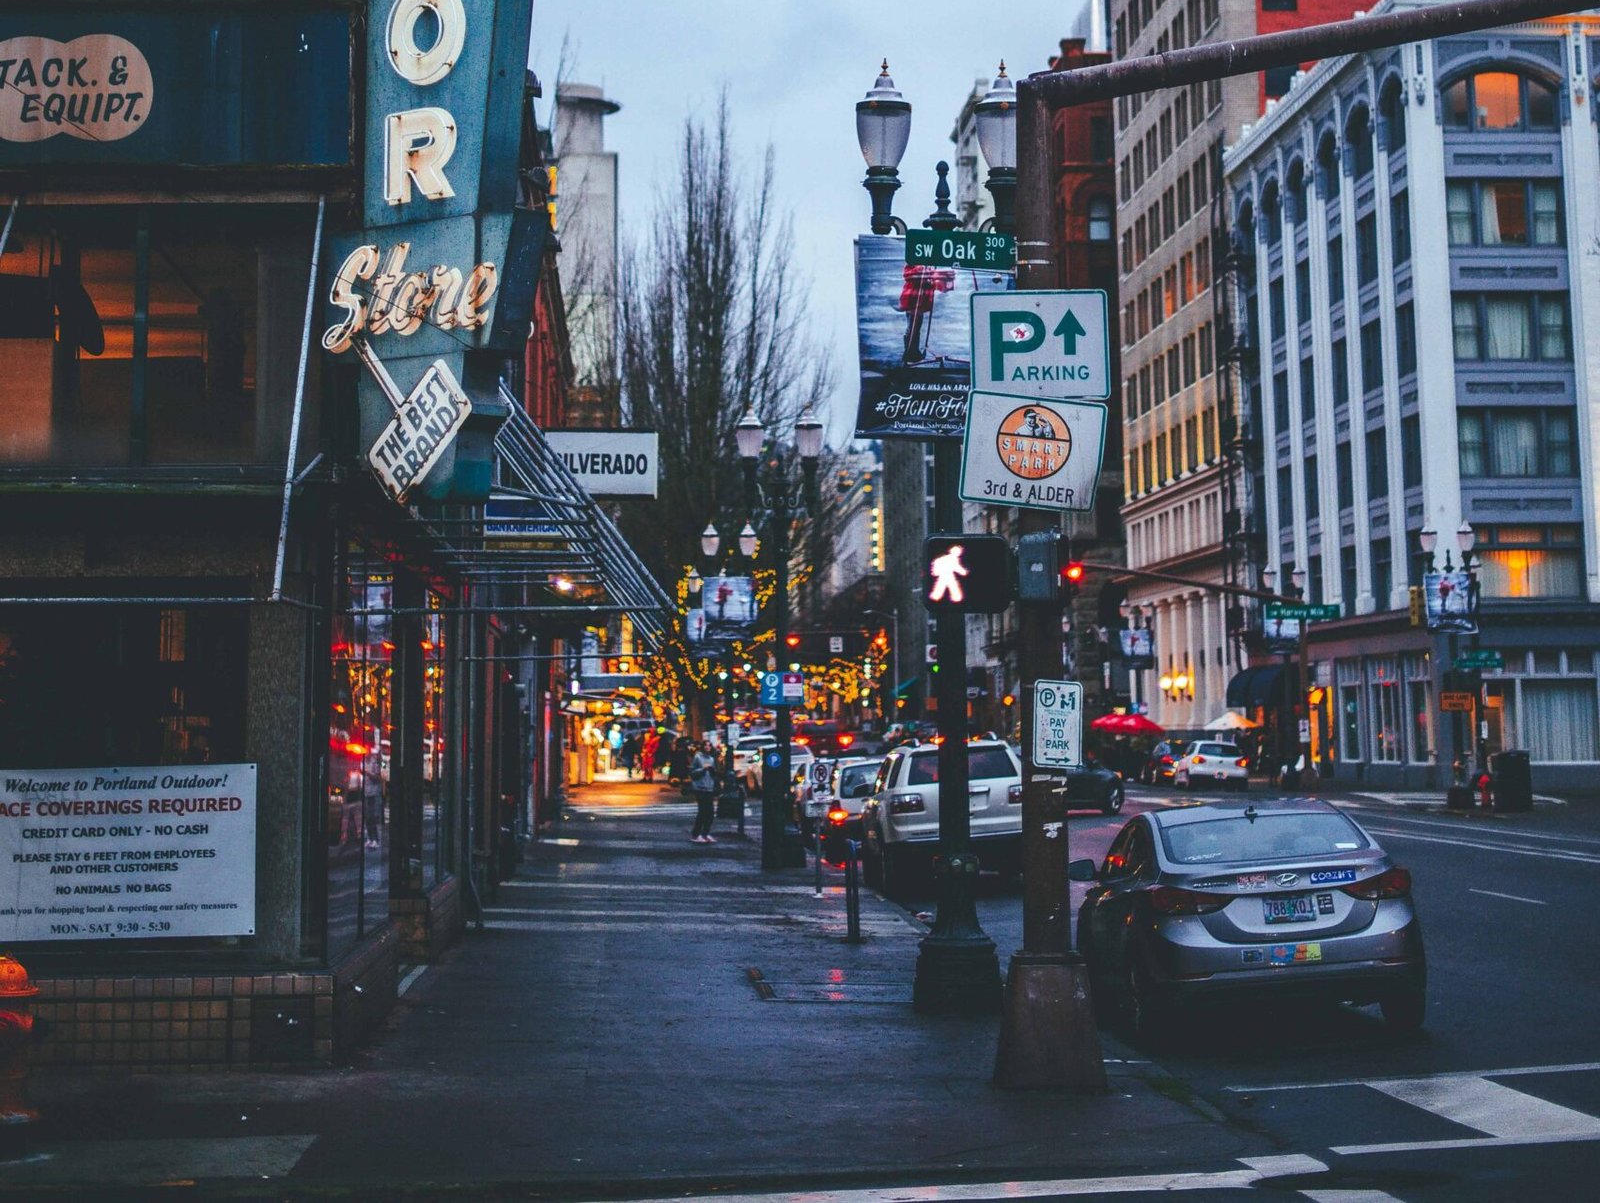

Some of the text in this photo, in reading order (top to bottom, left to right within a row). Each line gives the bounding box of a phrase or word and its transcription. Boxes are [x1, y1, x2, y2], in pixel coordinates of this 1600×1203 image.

[108, 55, 128, 86] &
[20, 92, 143, 125] EQUIPT.
[915, 239, 995, 261] SW Oak St
[985, 237, 1005, 248] 300
[322, 242, 498, 354] Store
[375, 371, 447, 469] THE BEST
[1002, 439, 1065, 456] SMART
[557, 452, 648, 476] ILVERADO
[1008, 455, 1056, 471] PARK
[984, 480, 1075, 504] 3rd & ALDER
[768, 688, 777, 701] 2
[1049, 718, 1067, 728] PAY
[1052, 729, 1064, 739] TO
[1045, 740, 1070, 750] PARK
[5, 774, 228, 793] Welcome to Portland Outdoor!
[36, 799, 143, 817] COVERINGS
[148, 797, 242, 816] REQUIRED
[22, 828, 69, 839] CREDIT
[72, 827, 105, 838] CARD
[109, 825, 143, 837] ONLY
[154, 825, 173, 836] NO
[176, 824, 209, 835] CASH
[13, 849, 216, 863] PLEASE STAY 6 FEET FROM EMPLOYEES
[50, 863, 179, 874] AND OTHER CUSTOMERS
[56, 883, 172, 895] NO ANIMALS NO BAGS
[17, 909, 32, 917] you
[34, 907, 46, 915] for
[48, 906, 85, 916] shopping
[86, 905, 104, 914] local
[107, 905, 115, 913] &
[117, 904, 158, 914] respecting
[175, 903, 199, 913] safety
[1265, 902, 1286, 917] 788
[50, 924, 79, 935] MON
[88, 923, 111, 934] SAT
[117, 922, 138, 933] 9:30
[148, 922, 170, 932] 5:30
